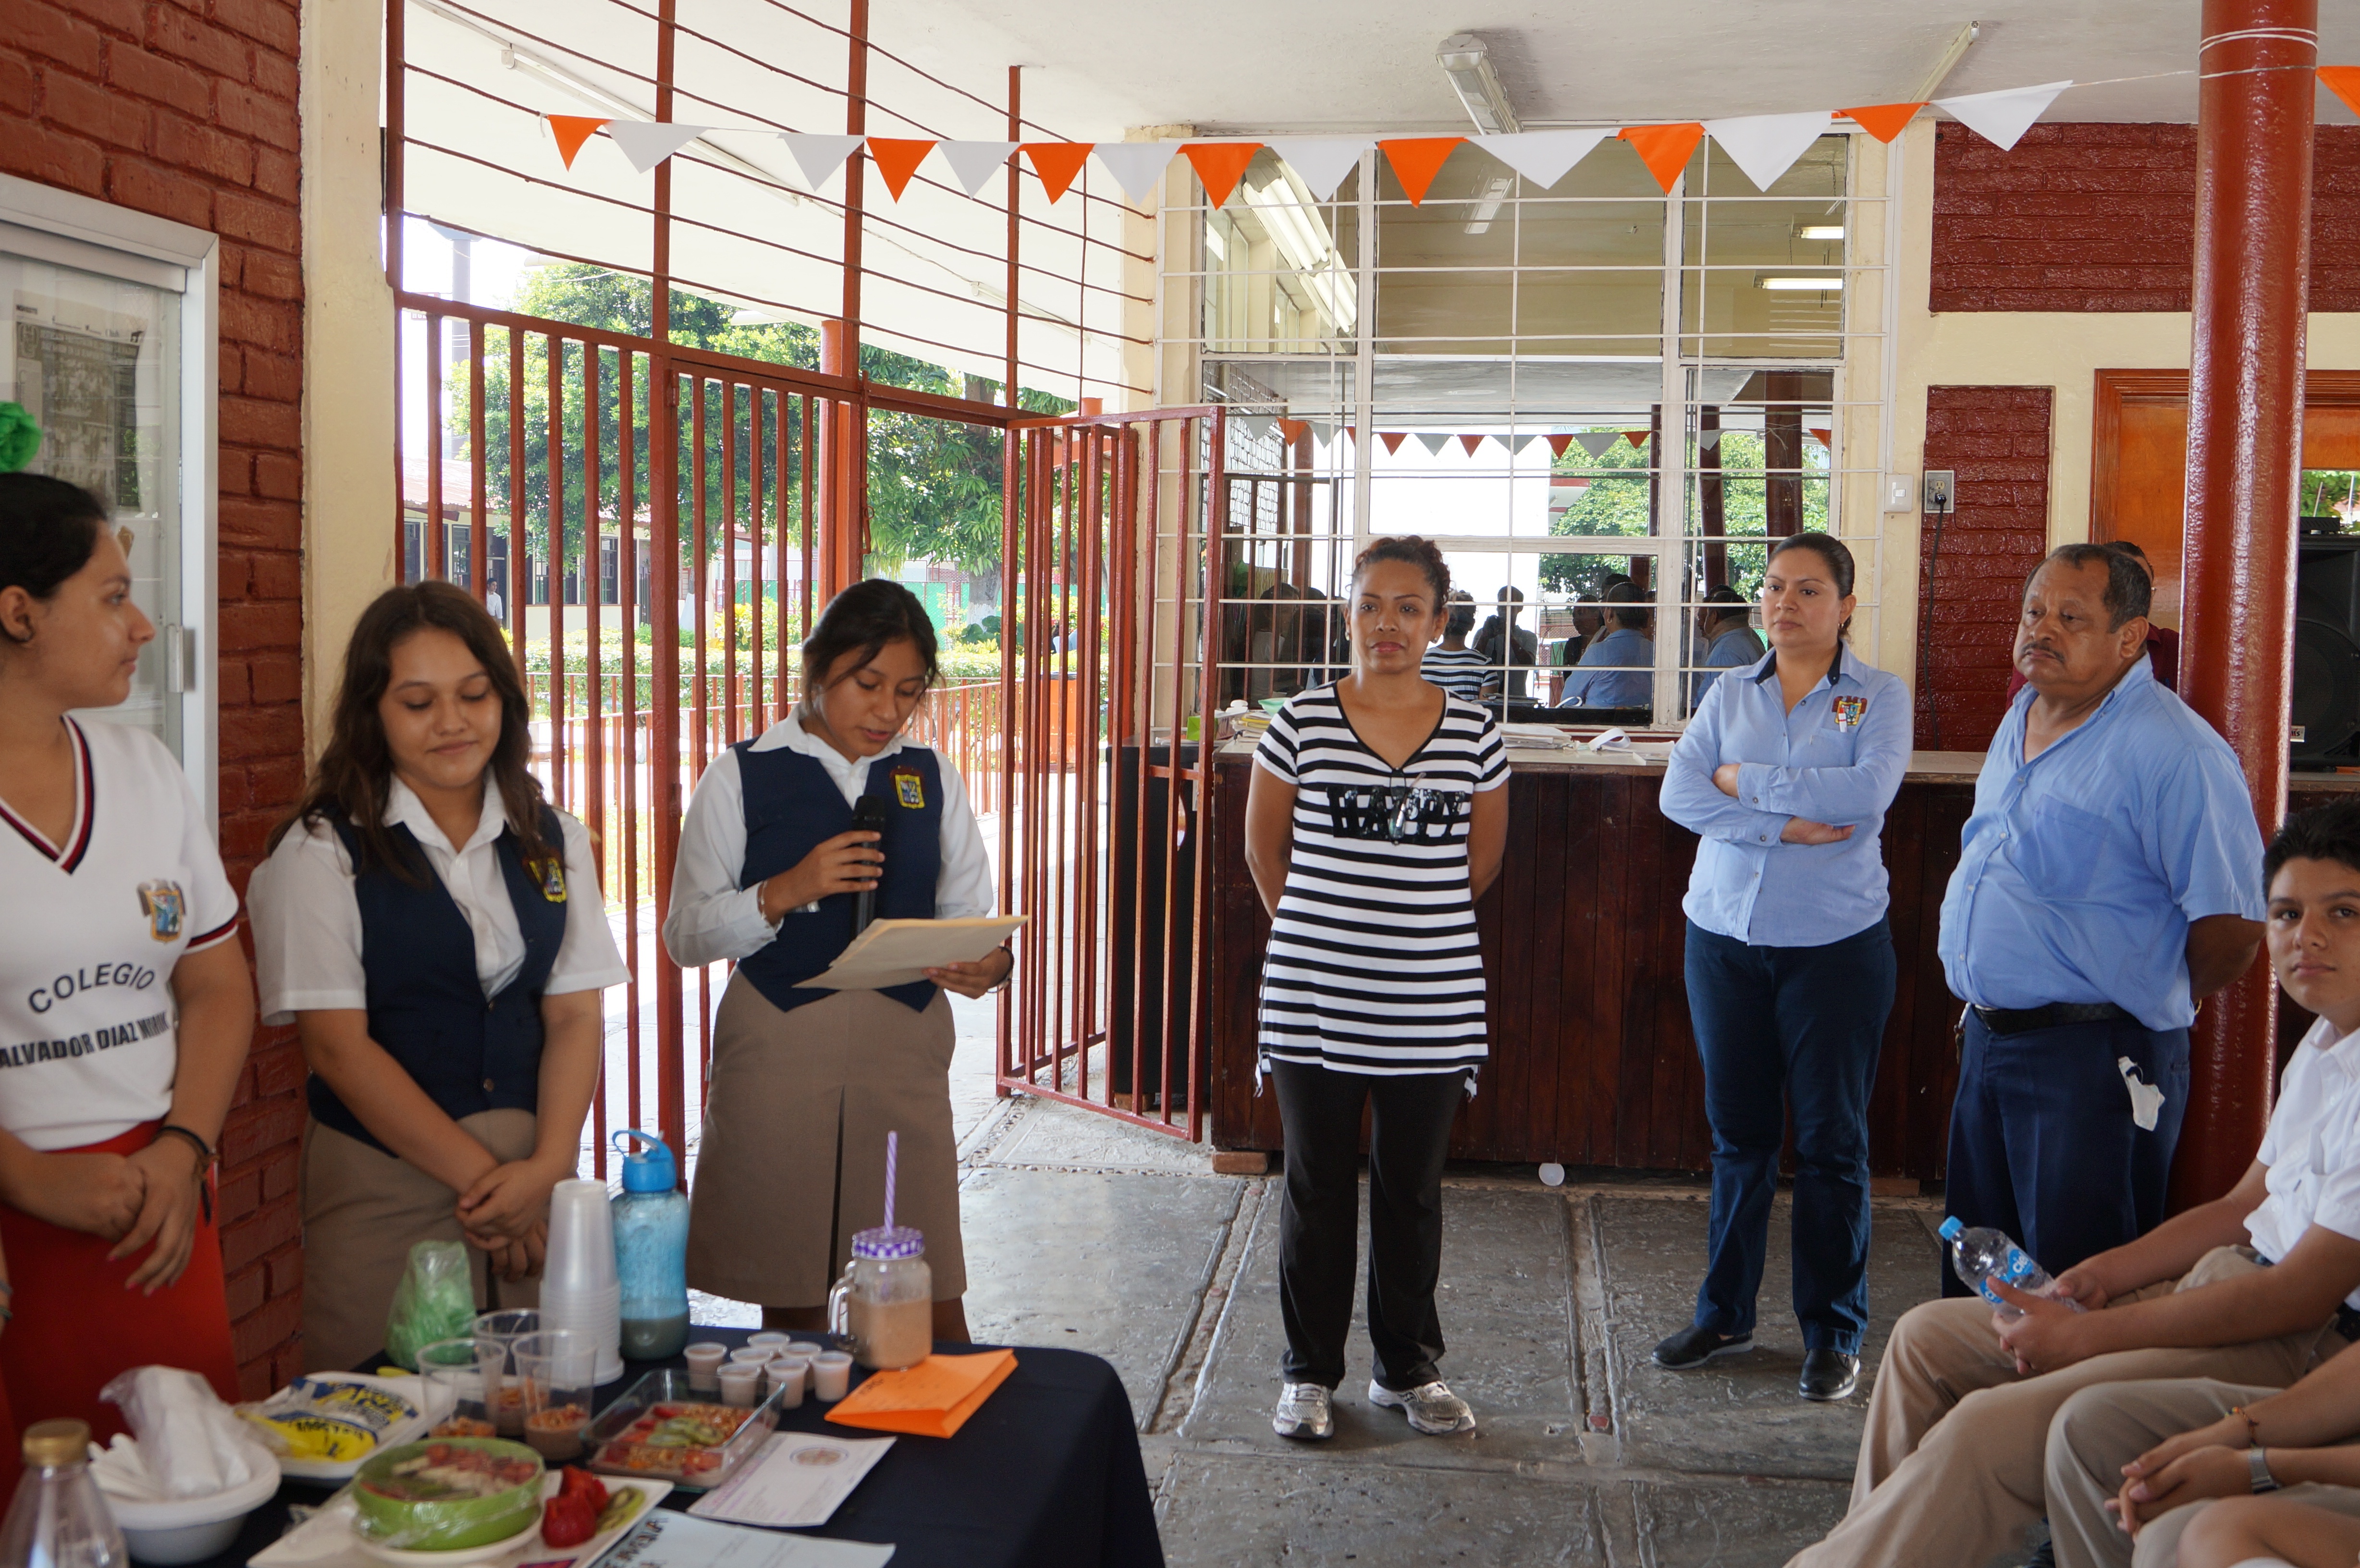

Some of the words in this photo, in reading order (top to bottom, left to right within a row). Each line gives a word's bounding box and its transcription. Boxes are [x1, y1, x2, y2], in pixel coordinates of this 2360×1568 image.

[28, 962, 155, 1014] COLEGIO
[0, 1034, 95, 1068] ALVADOR
[96, 1021, 139, 1050] DIAZ
